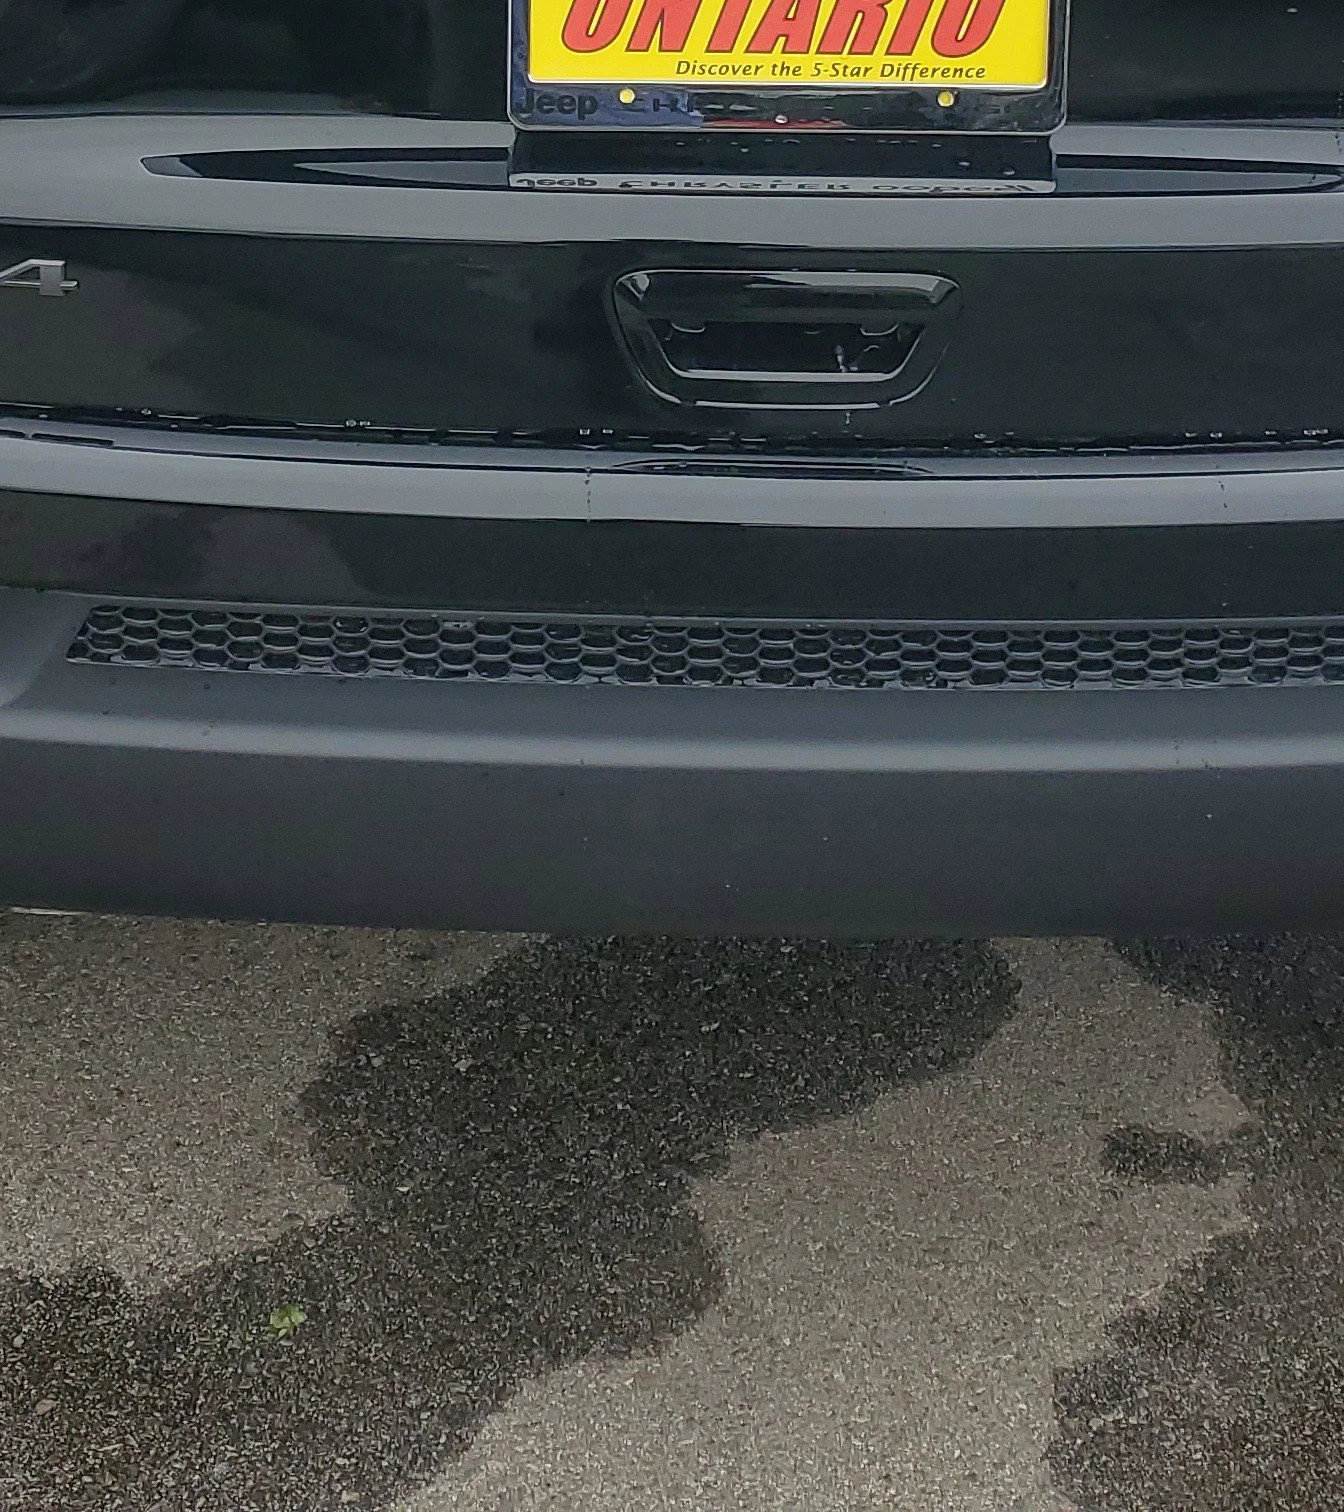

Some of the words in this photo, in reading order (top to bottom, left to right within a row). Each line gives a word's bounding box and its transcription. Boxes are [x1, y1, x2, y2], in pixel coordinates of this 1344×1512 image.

[675, 59, 764, 78] Discover
[771, 61, 802, 77] the
[811, 62, 873, 79] 5-Star
[879, 63, 987, 82] Difference
[514, 88, 599, 121] Jeep
